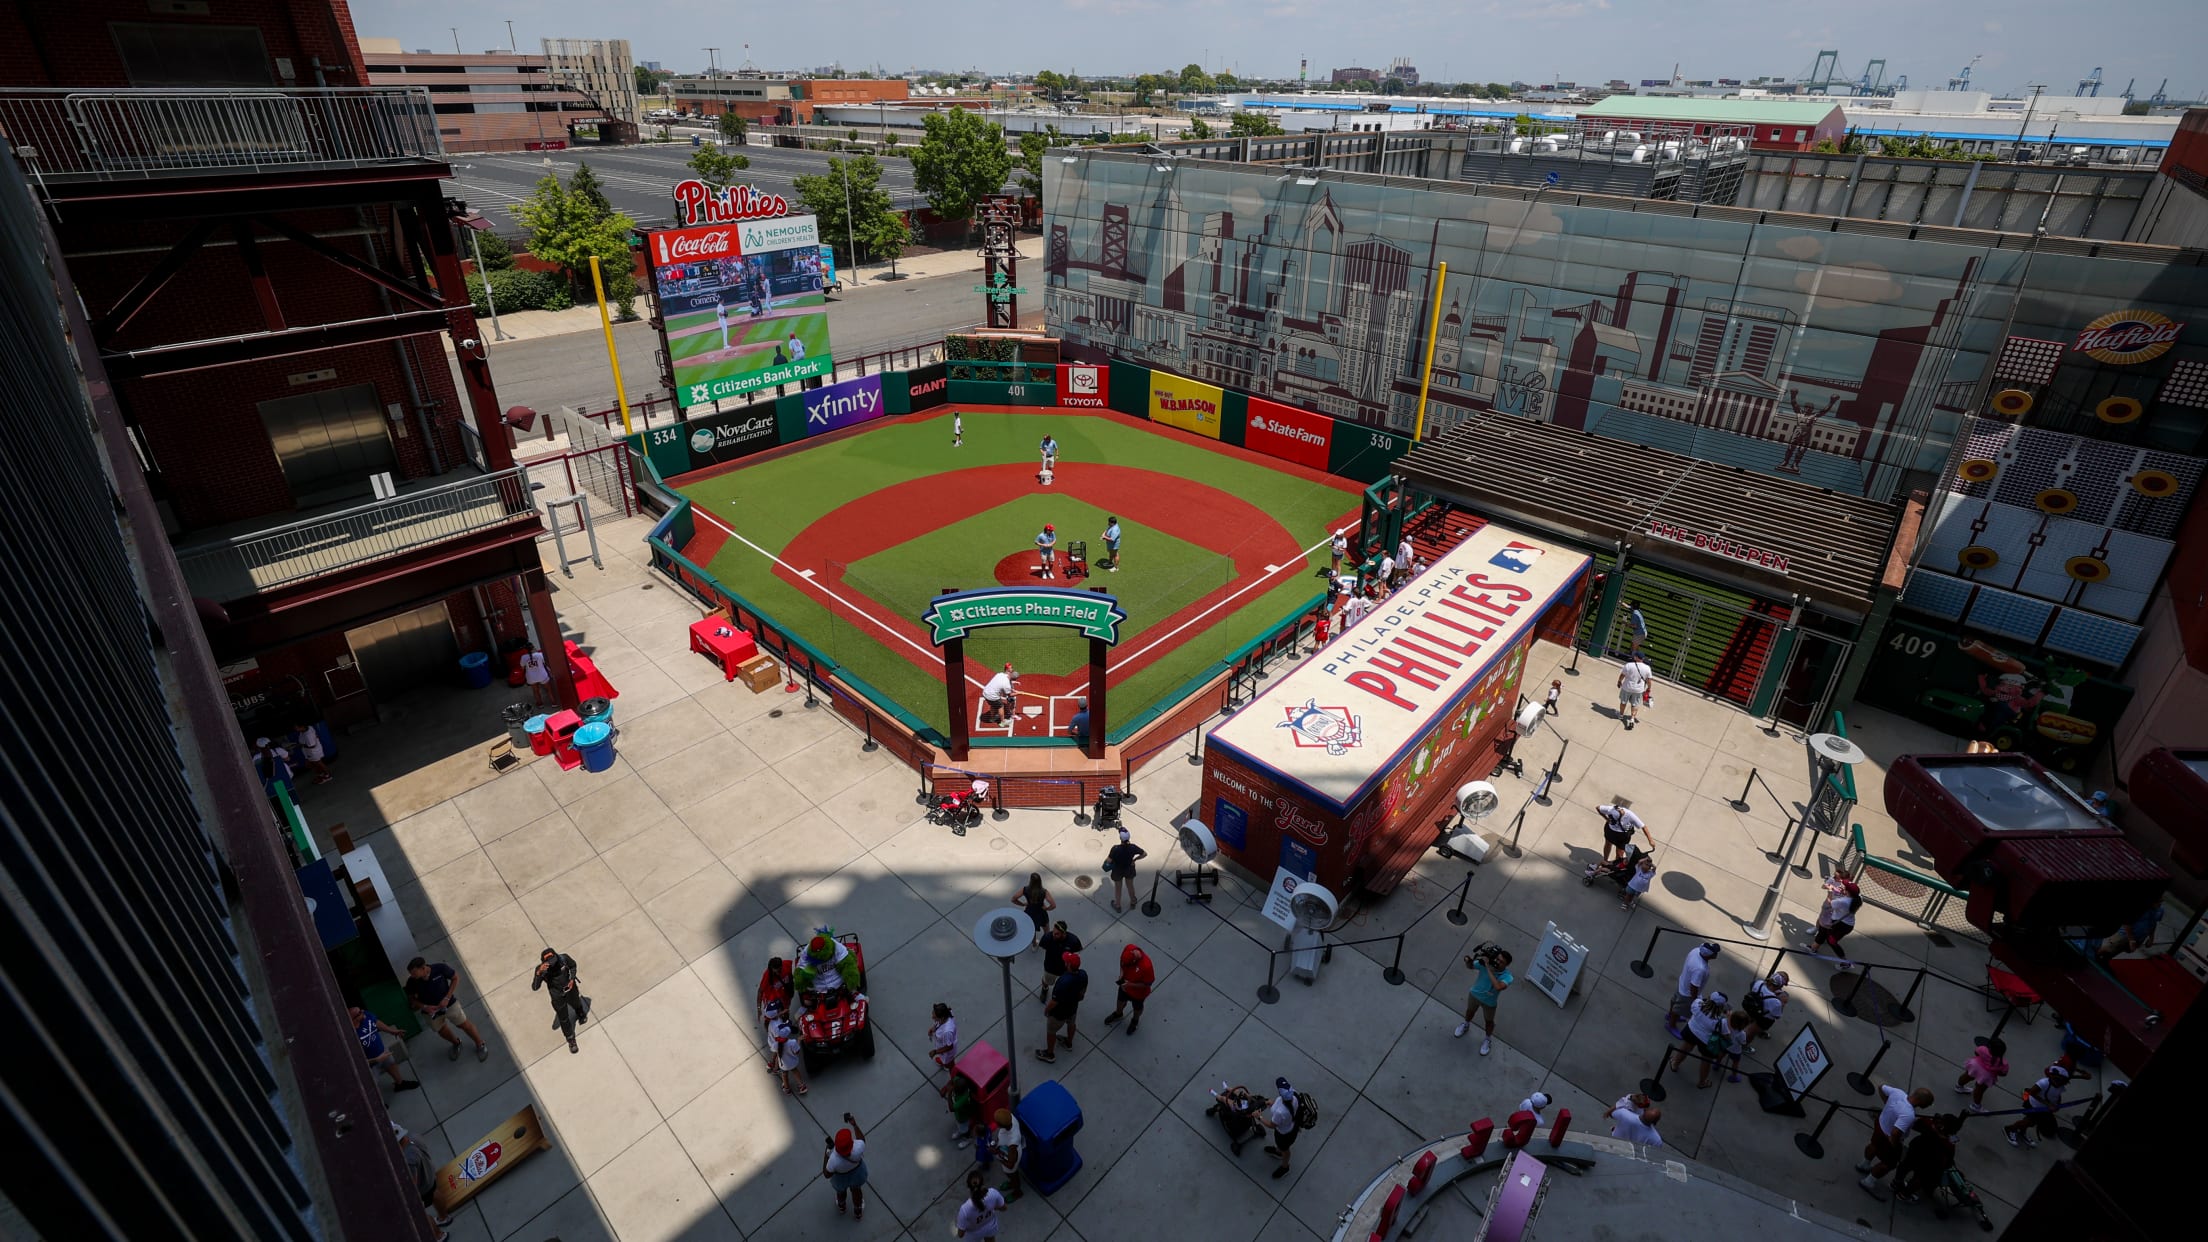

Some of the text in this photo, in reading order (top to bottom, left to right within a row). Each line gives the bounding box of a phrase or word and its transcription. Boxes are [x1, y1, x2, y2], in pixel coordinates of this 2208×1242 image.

[674, 179, 788, 225] Phillies
[671, 231, 731, 258] Coca-Cola
[766, 224, 814, 238] NEMOURS
[766, 234, 815, 246] CHILDREN'S HEALTH
[1709, 302, 1779, 320] GO PHILLIES
[2071, 322, 2187, 351] Hatfield
[712, 361, 819, 396] Citizens Bank Park
[909, 377, 947, 397] GIANT
[1007, 385, 1025, 397] 401
[807, 387, 881, 426] xfinity
[1062, 397, 1104, 407] TOYOTA
[653, 428, 678, 446] 334
[715, 416, 774, 441] NovaCare
[717, 427, 773, 449] REHABILITATION
[1370, 432, 1392, 450] 330
[1650, 520, 1790, 572] THE BULLPEN
[966, 602, 1098, 621] Citizens Phan Field
[1322, 566, 1465, 676] PHILADELPHIA
[1344, 573, 1533, 713] PHILLIES
[1889, 632, 1937, 659] 409
[1430, 739, 1457, 775] play
[1213, 768, 1274, 810] WELCOME TO THE
[1275, 797, 1329, 846] Yard
